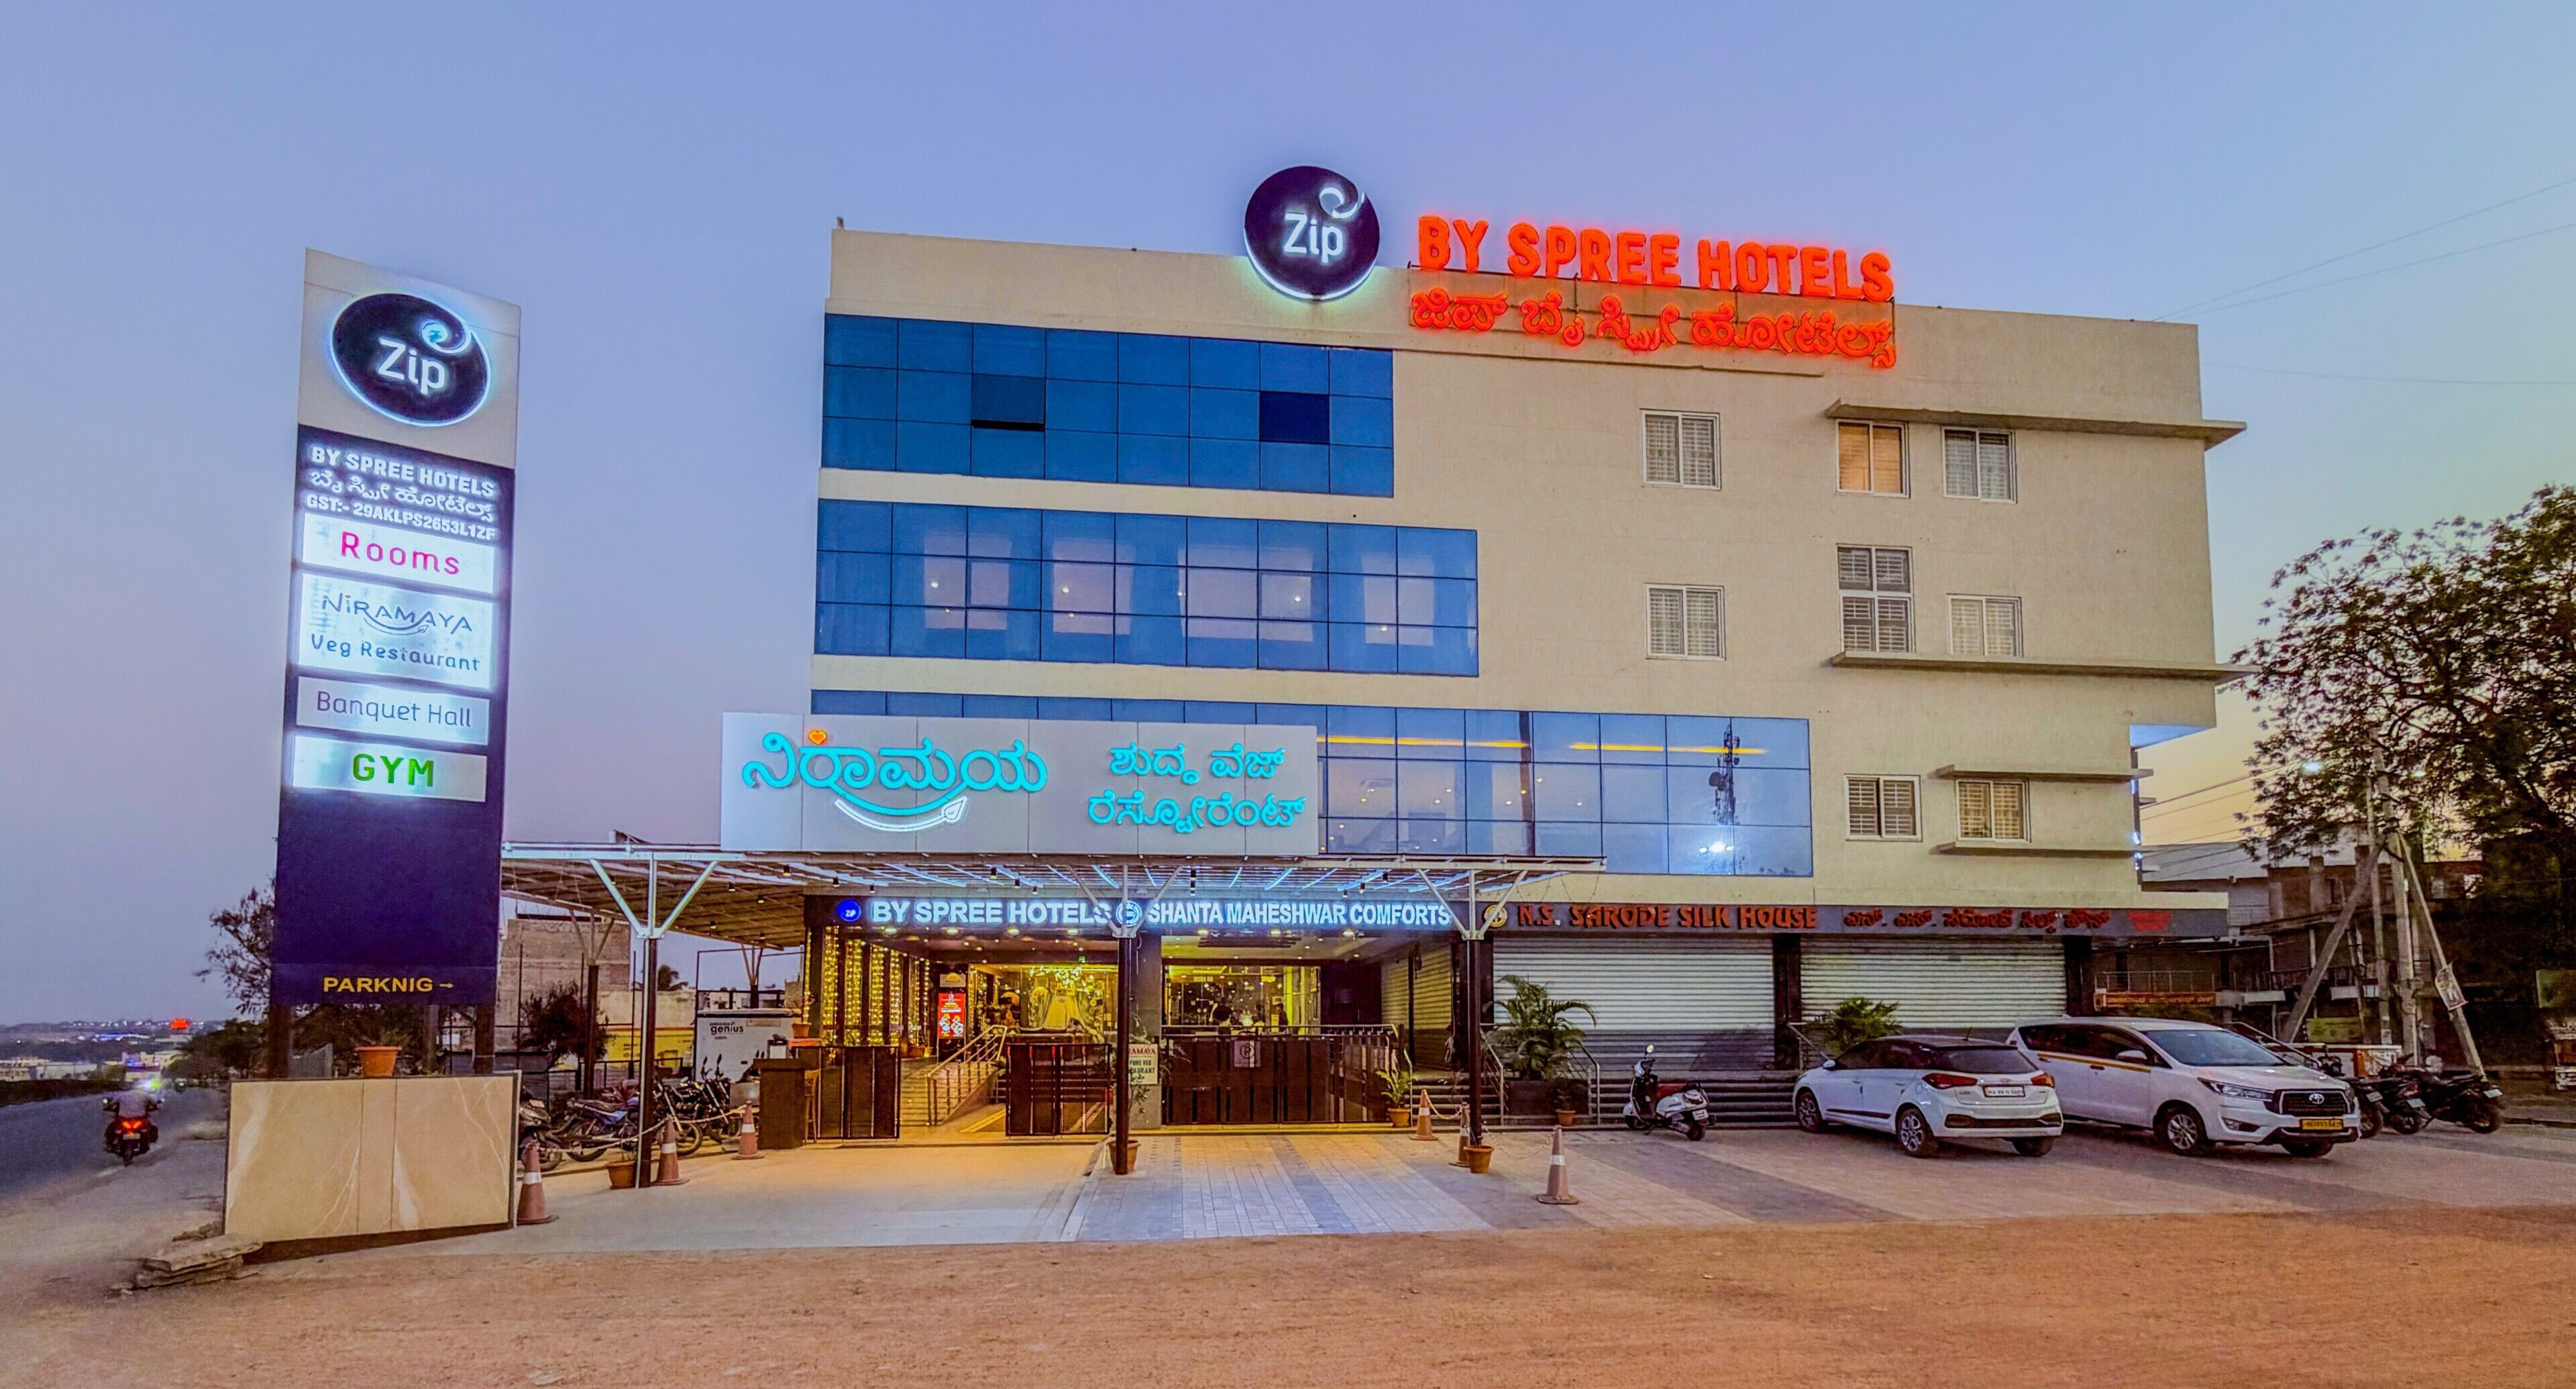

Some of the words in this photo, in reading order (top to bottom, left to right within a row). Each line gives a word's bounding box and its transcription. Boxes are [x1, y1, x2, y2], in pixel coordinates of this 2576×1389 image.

[1283, 212, 1343, 263] Zip
[1418, 215, 1489, 272] BY
[1507, 223, 1681, 287] SPREE
[1697, 239, 1895, 302] HOTELS
[1520, 290, 1585, 346] ಬೈ
[378, 337, 446, 395] Zip
[311, 446, 341, 466] BY
[345, 453, 415, 482] SPREE
[419, 467, 495, 498] HOTELS
[341, 531, 460, 576] Rooms
[311, 633, 352, 658] Veg
[361, 641, 481, 672] Restaurant
[316, 690, 421, 722] Banquet
[428, 705, 472, 727] Hall
[352, 753, 435, 787] GYM
[741, 731, 1048, 815] ನಿರಾಮಯ
[1210, 743, 1286, 779] ವೆಜ್
[873, 901, 910, 923] BY
[915, 901, 1003, 923] SPREE
[1008, 902, 1112, 924] HOTELS
[1148, 902, 1224, 925] SHANTA
[1226, 902, 1347, 925] MAHESHWAR
[1350, 903, 1452, 925] COMFORTS
[1569, 905, 1670, 929] SARODE
[1678, 906, 1731, 928] SILK
[1737, 905, 1818, 929] HOUSE
[323, 976, 433, 993] PARKNIG
[710, 1025, 744, 1035] genius
